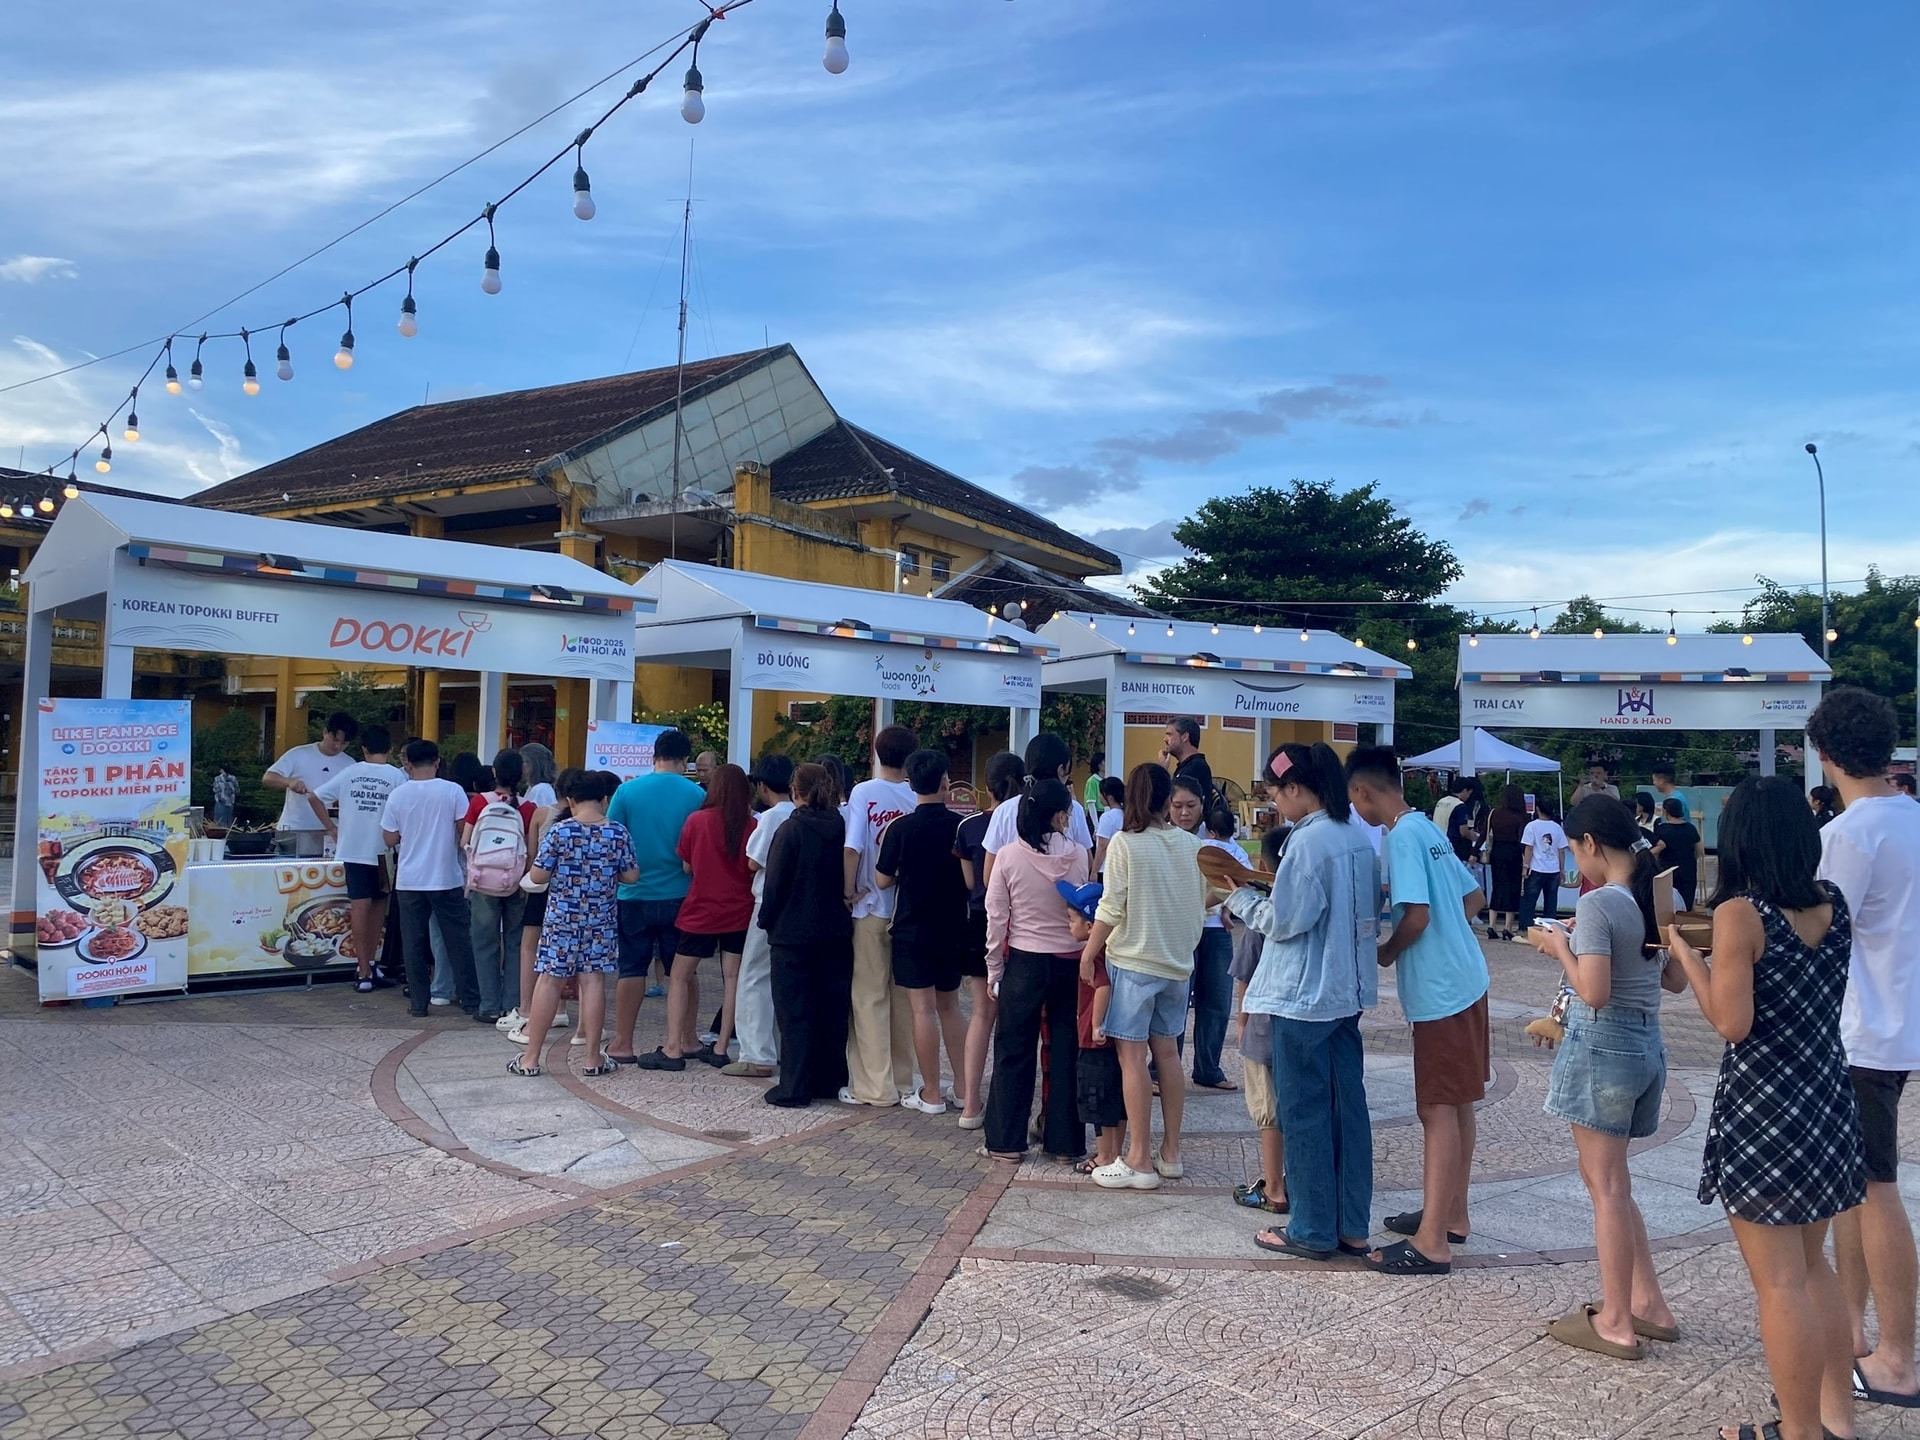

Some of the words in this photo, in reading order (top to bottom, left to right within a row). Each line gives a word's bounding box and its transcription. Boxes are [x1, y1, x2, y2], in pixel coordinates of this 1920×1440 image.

[122, 599, 175, 614] KOREAN
[179, 604, 232, 619] TOPOKKI
[236, 610, 280, 623] BUFFET
[330, 617, 474, 659] DOOKKI
[578, 637, 601, 646] FOOD
[604, 639, 624, 647] 2025
[578, 645, 589, 654] IN
[592, 646, 609, 655] HOI
[612, 648, 626, 656] AN
[881, 681, 901, 690] foods
[882, 671, 931, 690] woongjin
[1121, 682, 1149, 693] BANH
[1152, 683, 1195, 695] HOTTEOK
[1235, 694, 1300, 712] Pulmuone
[1472, 699, 1498, 709] TRAI
[1502, 699, 1525, 709] CAY
[1600, 717, 1630, 725] HAND
[1632, 717, 1639, 725] &
[1642, 717, 1672, 725] HAND
[53, 728, 93, 741] LIKE
[98, 724, 178, 739] FANPAGE
[82, 740, 151, 755] DOOKKI
[595, 744, 618, 754] LIKE
[621, 744, 654, 754] FANPA
[611, 756, 652, 766] DOOKKI
[84, 767, 94, 783] 1
[106, 757, 184, 782] PHẦN
[44, 776, 78, 785] NGAY
[51, 787, 113, 798] TOPOKKI
[275, 863, 346, 894] DOO
[76, 968, 114, 980] DOOKKI
[134, 964, 147, 973] AN
